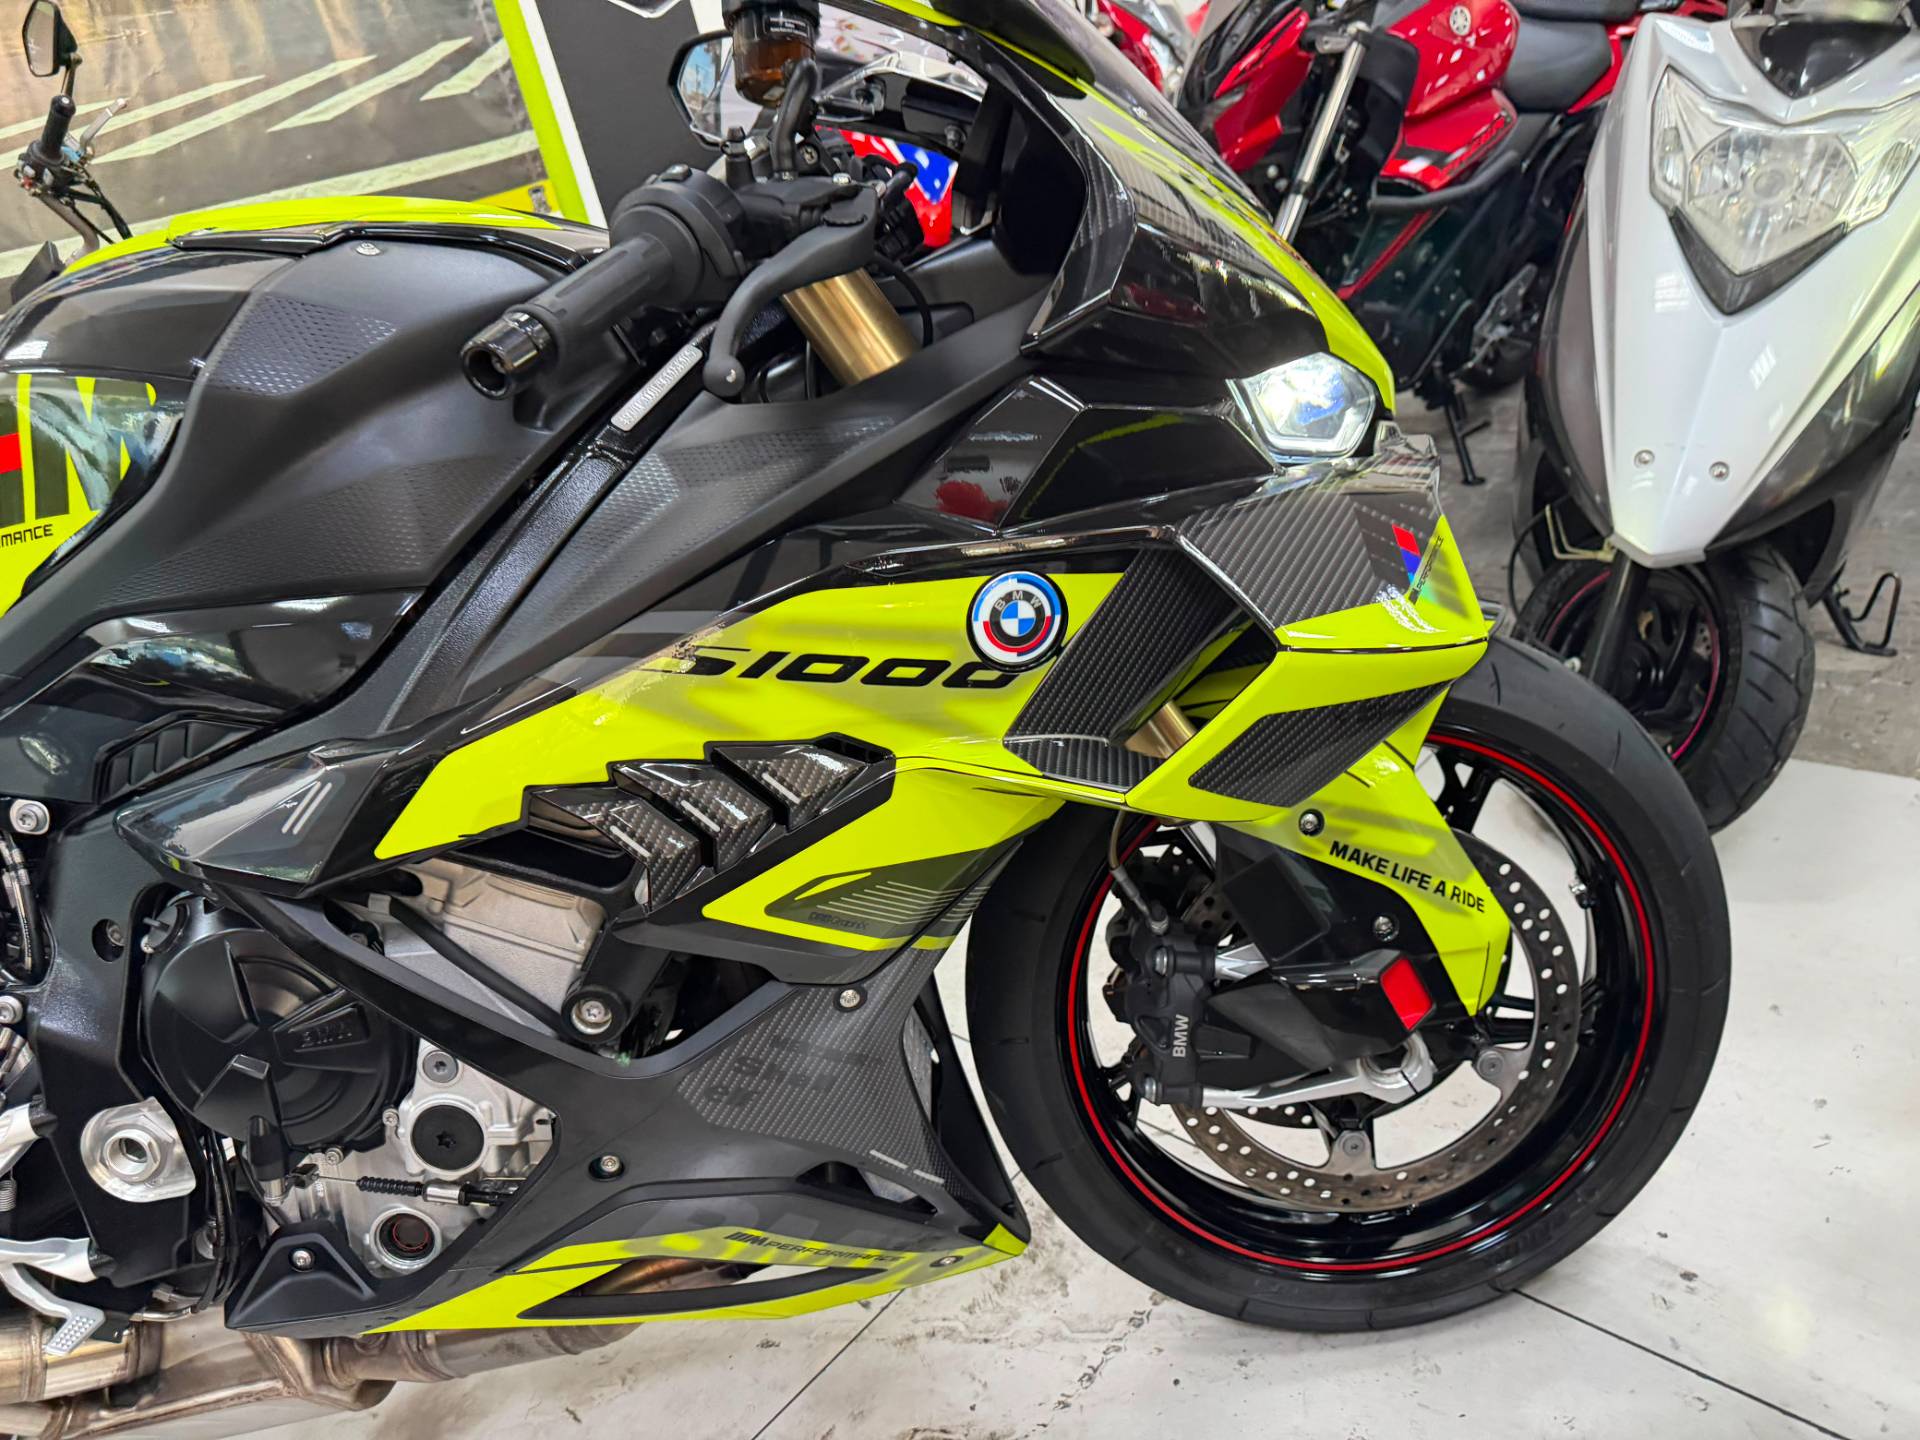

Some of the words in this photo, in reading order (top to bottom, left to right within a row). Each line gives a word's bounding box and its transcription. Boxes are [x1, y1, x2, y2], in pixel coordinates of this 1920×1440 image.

[0, 523, 54, 548] MANCE
[994, 590, 1042, 611] BMW
[1329, 840, 1390, 875] MAKE
[1390, 863, 1432, 890] LIFE
[1433, 880, 1446, 897] A
[1451, 885, 1486, 913] RIDE
[1172, 1014, 1190, 1058] BMW
